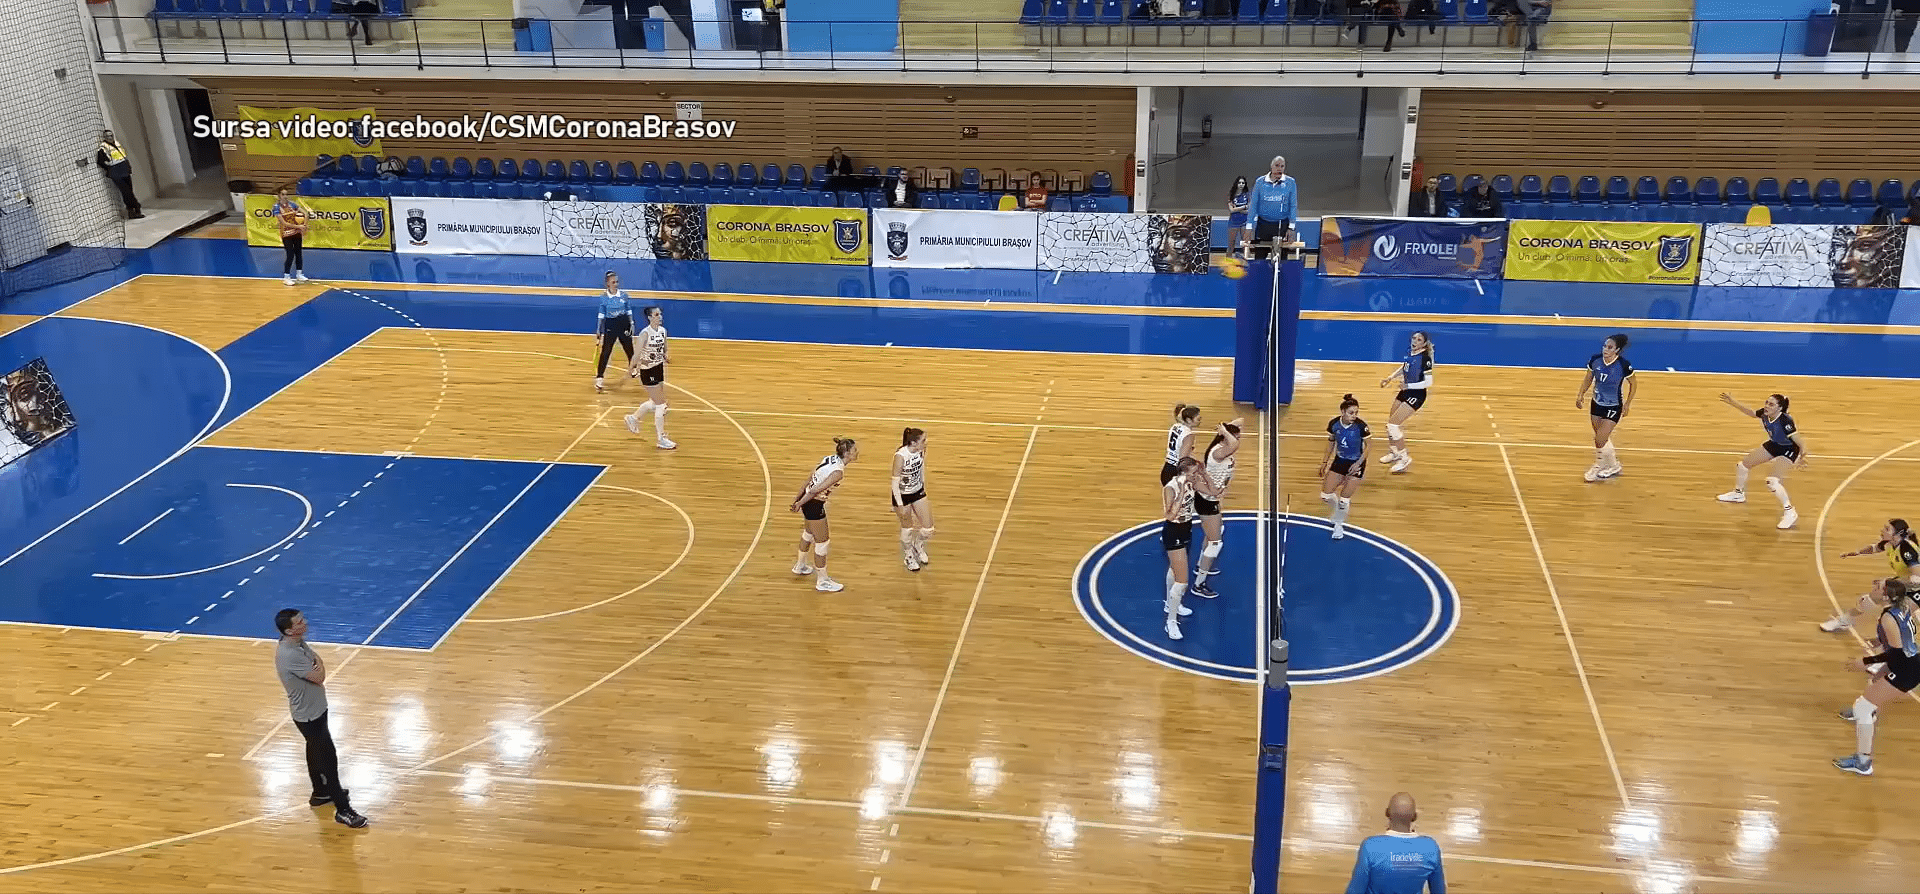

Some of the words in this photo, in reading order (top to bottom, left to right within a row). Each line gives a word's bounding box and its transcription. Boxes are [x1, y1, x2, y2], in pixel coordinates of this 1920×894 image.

[469, 224, 513, 235] MUNICIPIULUI
[568, 213, 631, 235] CREATIVA
[716, 221, 771, 232] CORONA
[717, 235, 728, 243] Un
[749, 235, 757, 244] O
[920, 235, 953, 246] PRIMĂRIA
[954, 236, 1001, 247] MUNICIPIULUI
[1063, 224, 1130, 247] CREATIVA
[1519, 237, 1584, 249] CORONA
[1733, 235, 1809, 260] CREATIVA
[1404, 242, 1458, 256] FRVOLEI
[1518, 252, 1530, 261] Un
[1555, 252, 1564, 261] O
[1600, 372, 1609, 382] 17
[1406, 396, 1418, 405] 10
[1606, 409, 1617, 419] 17
[1341, 436, 1348, 446] 4
